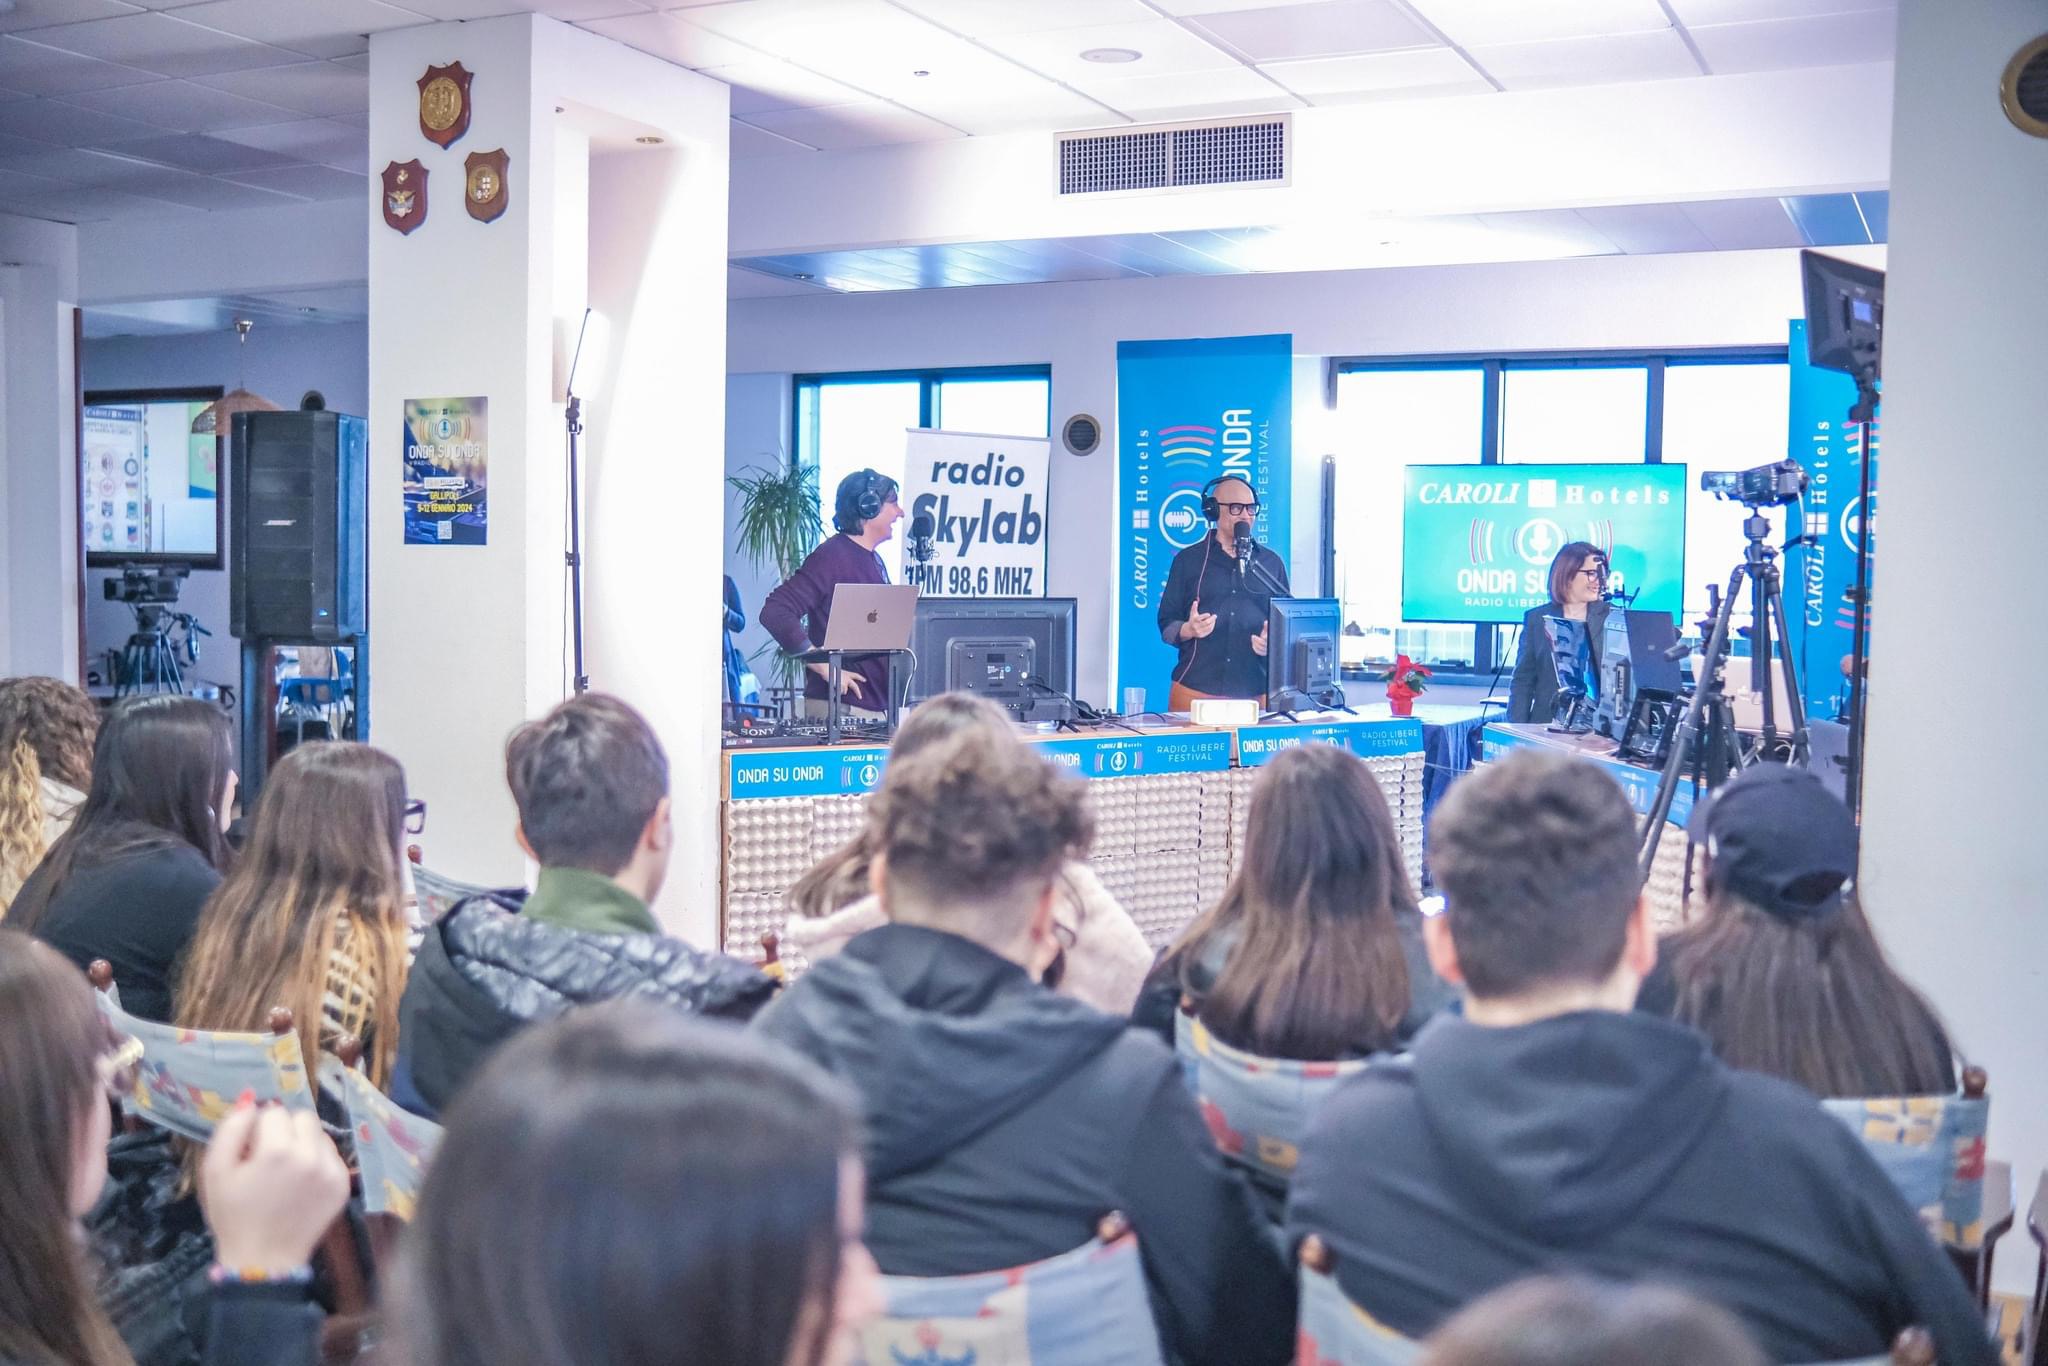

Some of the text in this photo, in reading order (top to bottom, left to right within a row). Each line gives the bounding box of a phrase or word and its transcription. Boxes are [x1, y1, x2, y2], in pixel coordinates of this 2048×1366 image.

[408, 445, 435, 459] ONDA
[455, 444, 480, 458] ONDA
[931, 452, 1025, 488] radio
[1257, 420, 1270, 544] BERE FESTIVAL
[430, 491, 459, 500] GALLIPOLI
[1418, 482, 1670, 505] CAROLI Hotels
[431, 503, 456, 513] GENNAIO
[457, 503, 473, 513] 2024
[907, 492, 1042, 558] Skylab
[1133, 429, 1149, 609] CAROLI Hotels
[1807, 420, 1830, 627] CAROLI Hotels
[949, 565, 988, 598] 98,6
[994, 566, 1033, 596] MHZ
[1457, 569, 1517, 594] ONDA
[1465, 597, 1504, 607] RADIO
[740, 727, 775, 736] SONY
[1361, 728, 1419, 739] RADIO LIBERE
[1157, 743, 1225, 754] RADIO LIBERE
[1243, 737, 1301, 753] ONDA SU ONDA
[1371, 737, 1409, 747] FESTIVAL
[1168, 753, 1213, 763] FESTIVAL
[737, 765, 824, 784] ONDA SU ONDA
